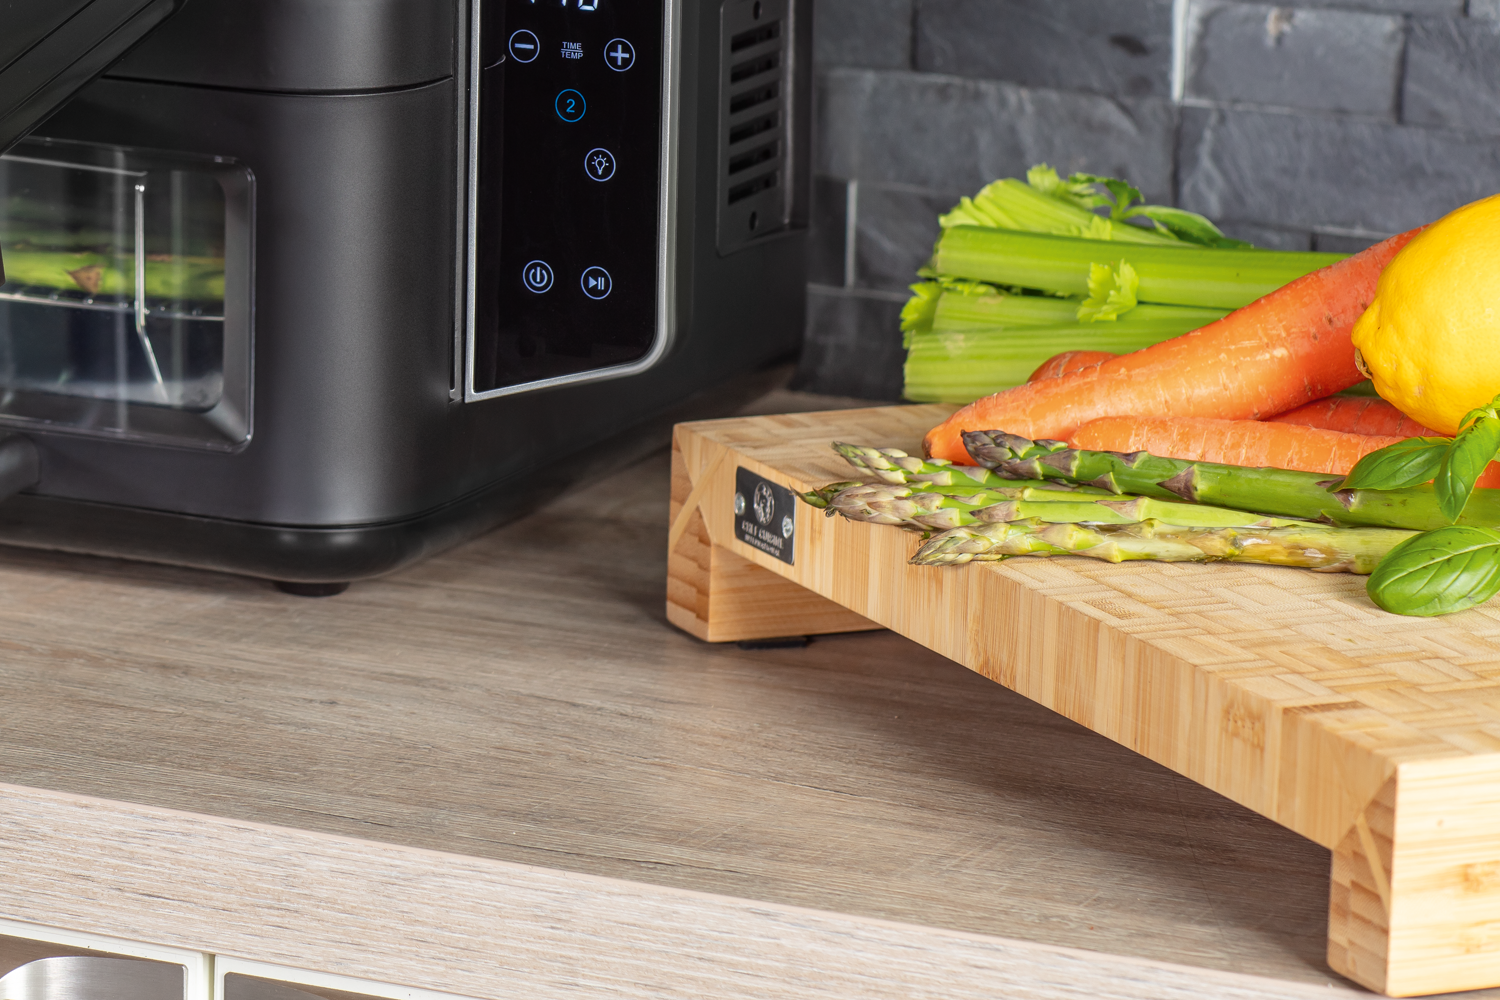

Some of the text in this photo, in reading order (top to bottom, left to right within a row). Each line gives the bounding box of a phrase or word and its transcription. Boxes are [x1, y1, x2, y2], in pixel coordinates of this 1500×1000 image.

[562, 41, 582, 50] TIME
[560, 51, 584, 60] TEMP
[566, 98, 576, 113] 2
